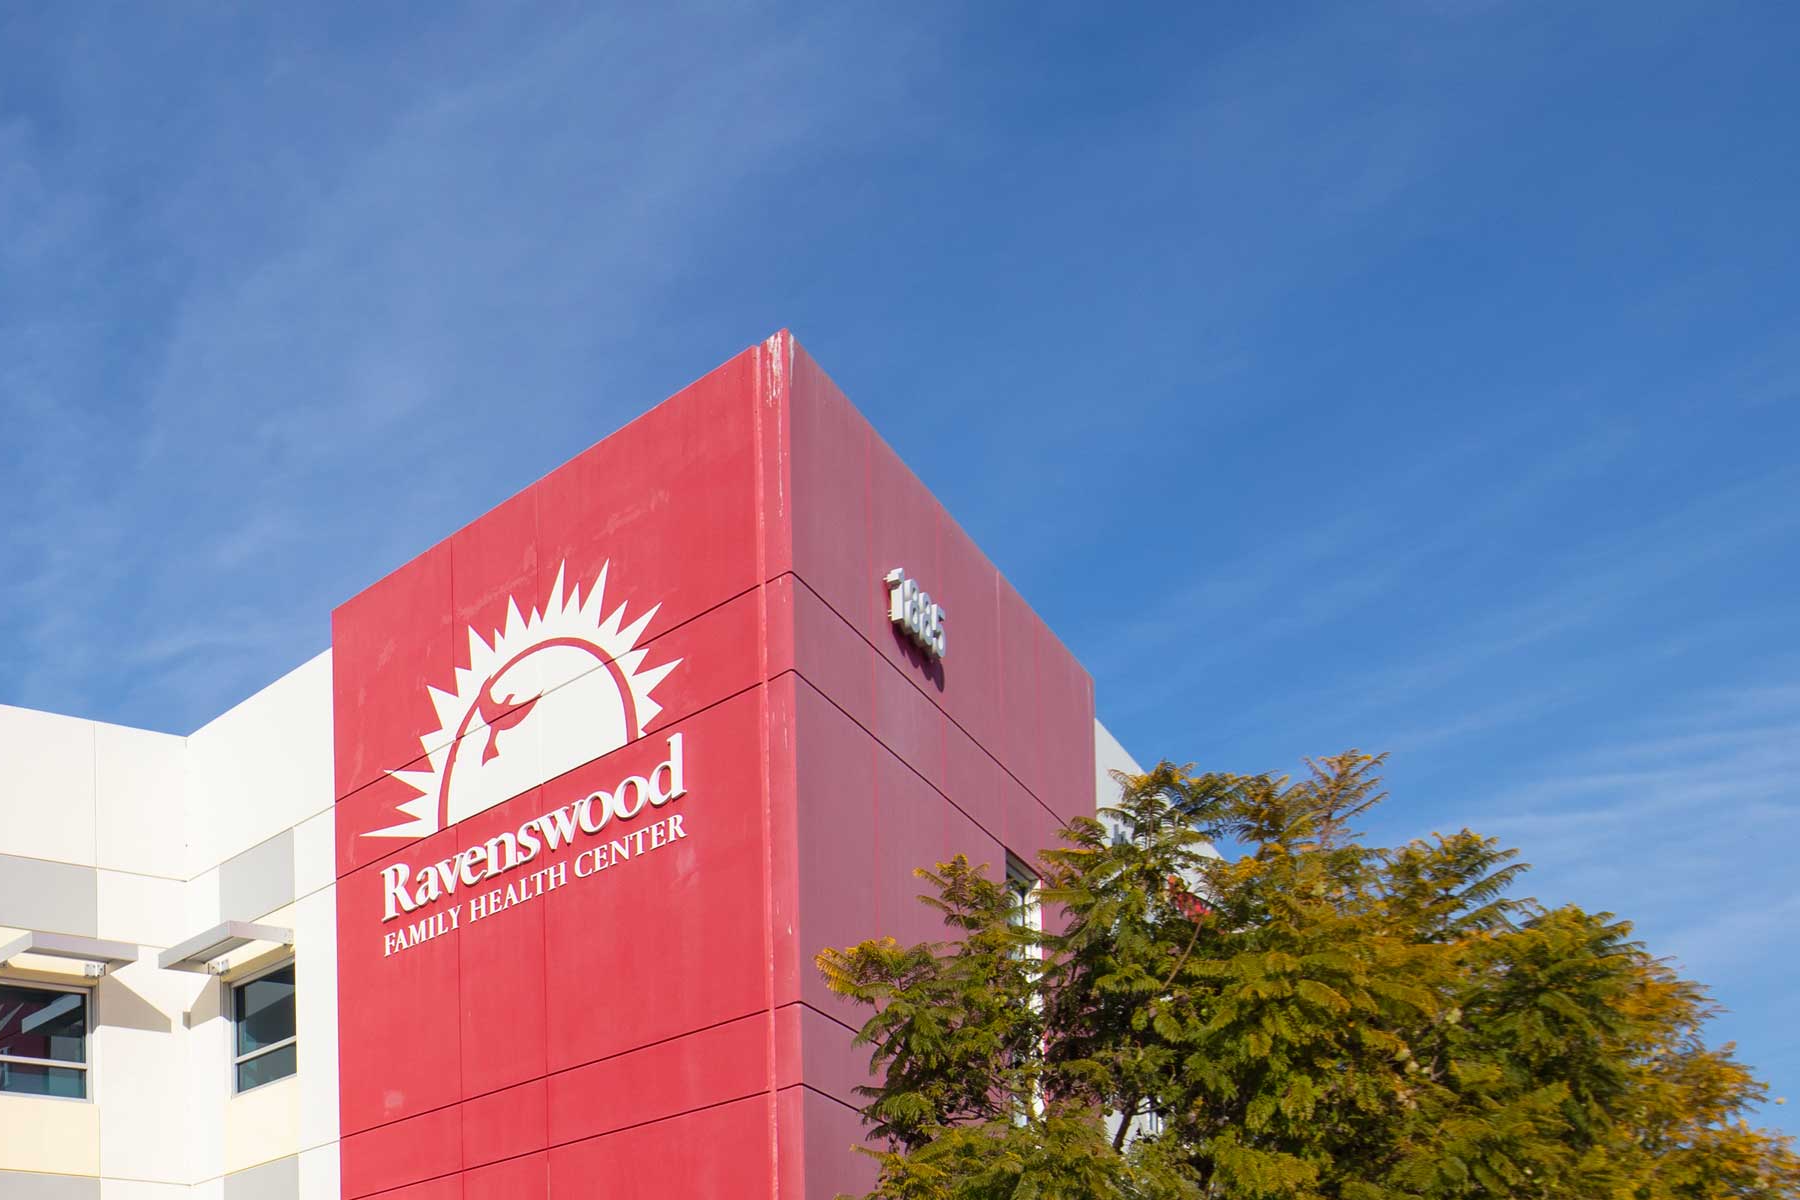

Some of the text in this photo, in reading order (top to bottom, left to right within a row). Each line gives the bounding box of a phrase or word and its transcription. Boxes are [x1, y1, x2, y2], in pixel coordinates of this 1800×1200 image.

[884, 567, 947, 658] 1885
[380, 732, 688, 924] Ravenswood
[383, 813, 688, 958] FAMILY HEALTH CENTER
